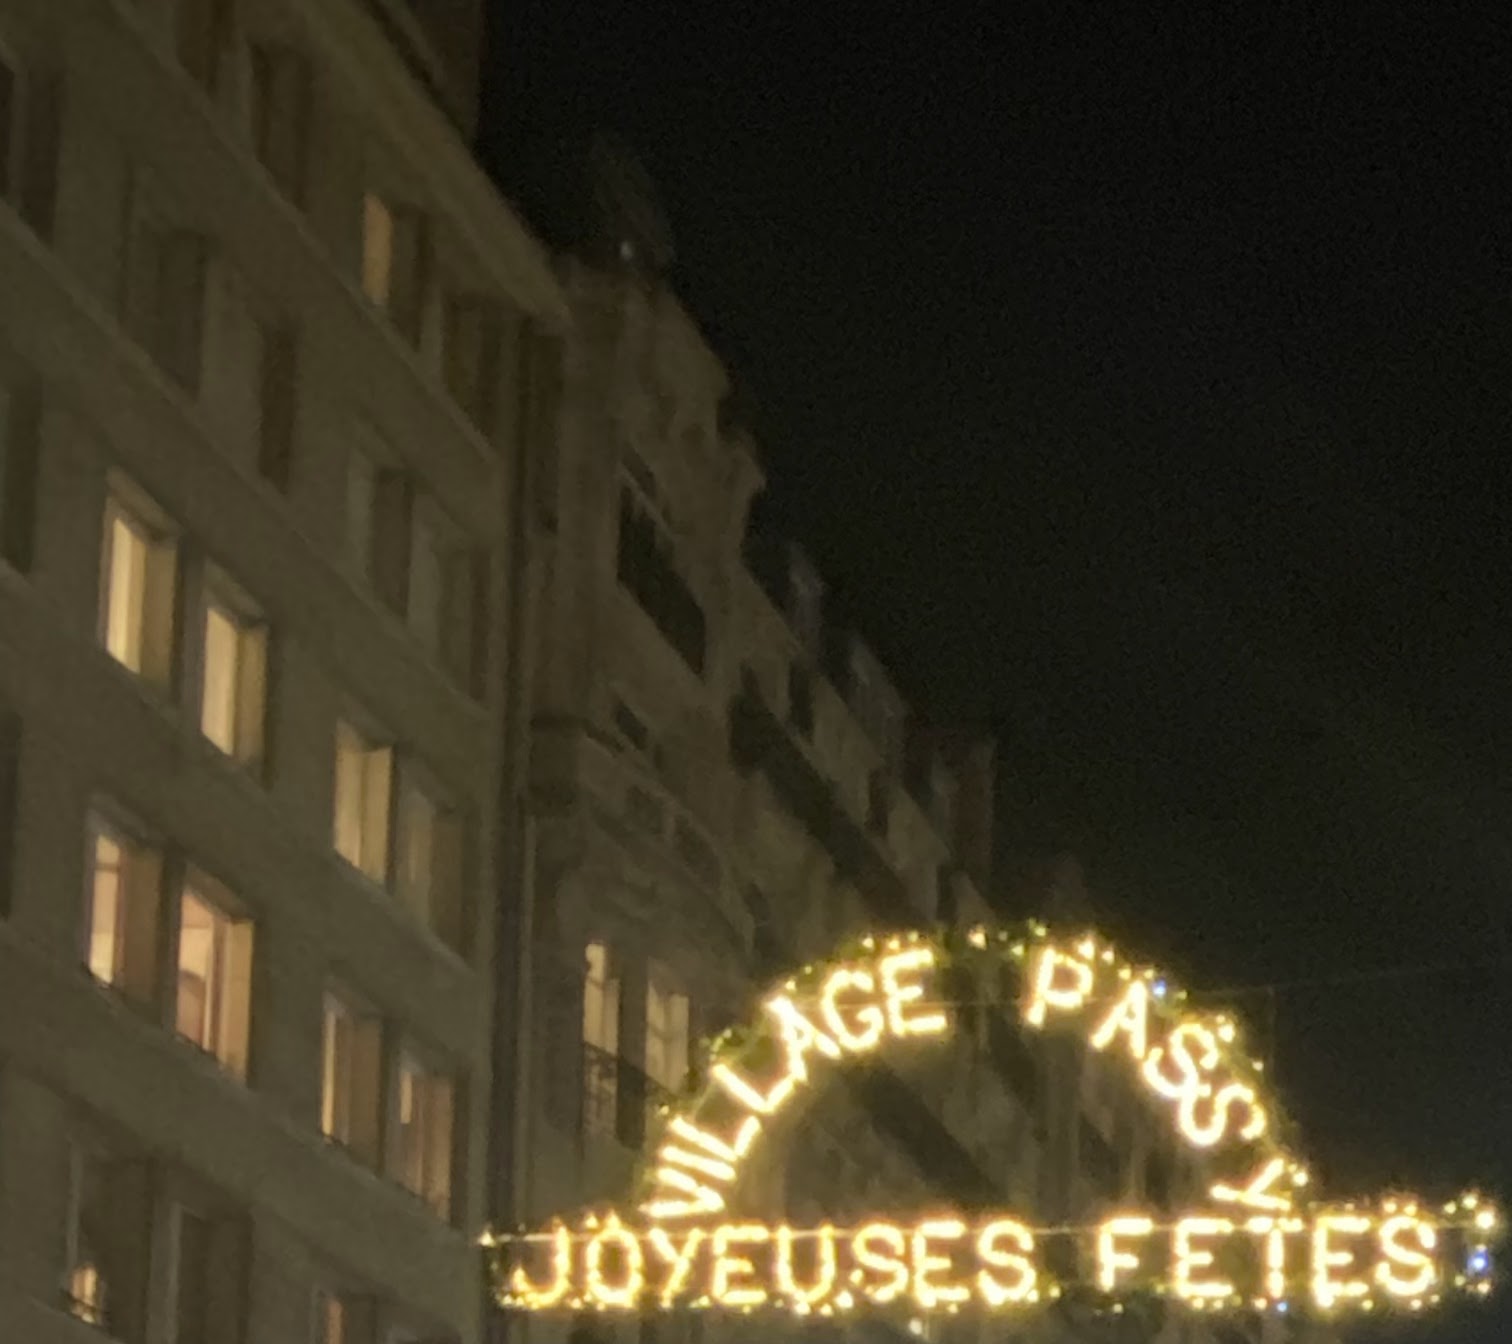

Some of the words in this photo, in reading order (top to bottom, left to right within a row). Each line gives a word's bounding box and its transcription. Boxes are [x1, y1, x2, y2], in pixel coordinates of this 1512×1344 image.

[644, 948, 947, 1219] VILLAGE
[1026, 948, 1291, 1211] PASSY
[512, 1219, 1038, 1307] JOYEUSES
[1098, 1216, 1437, 1306] FETES
